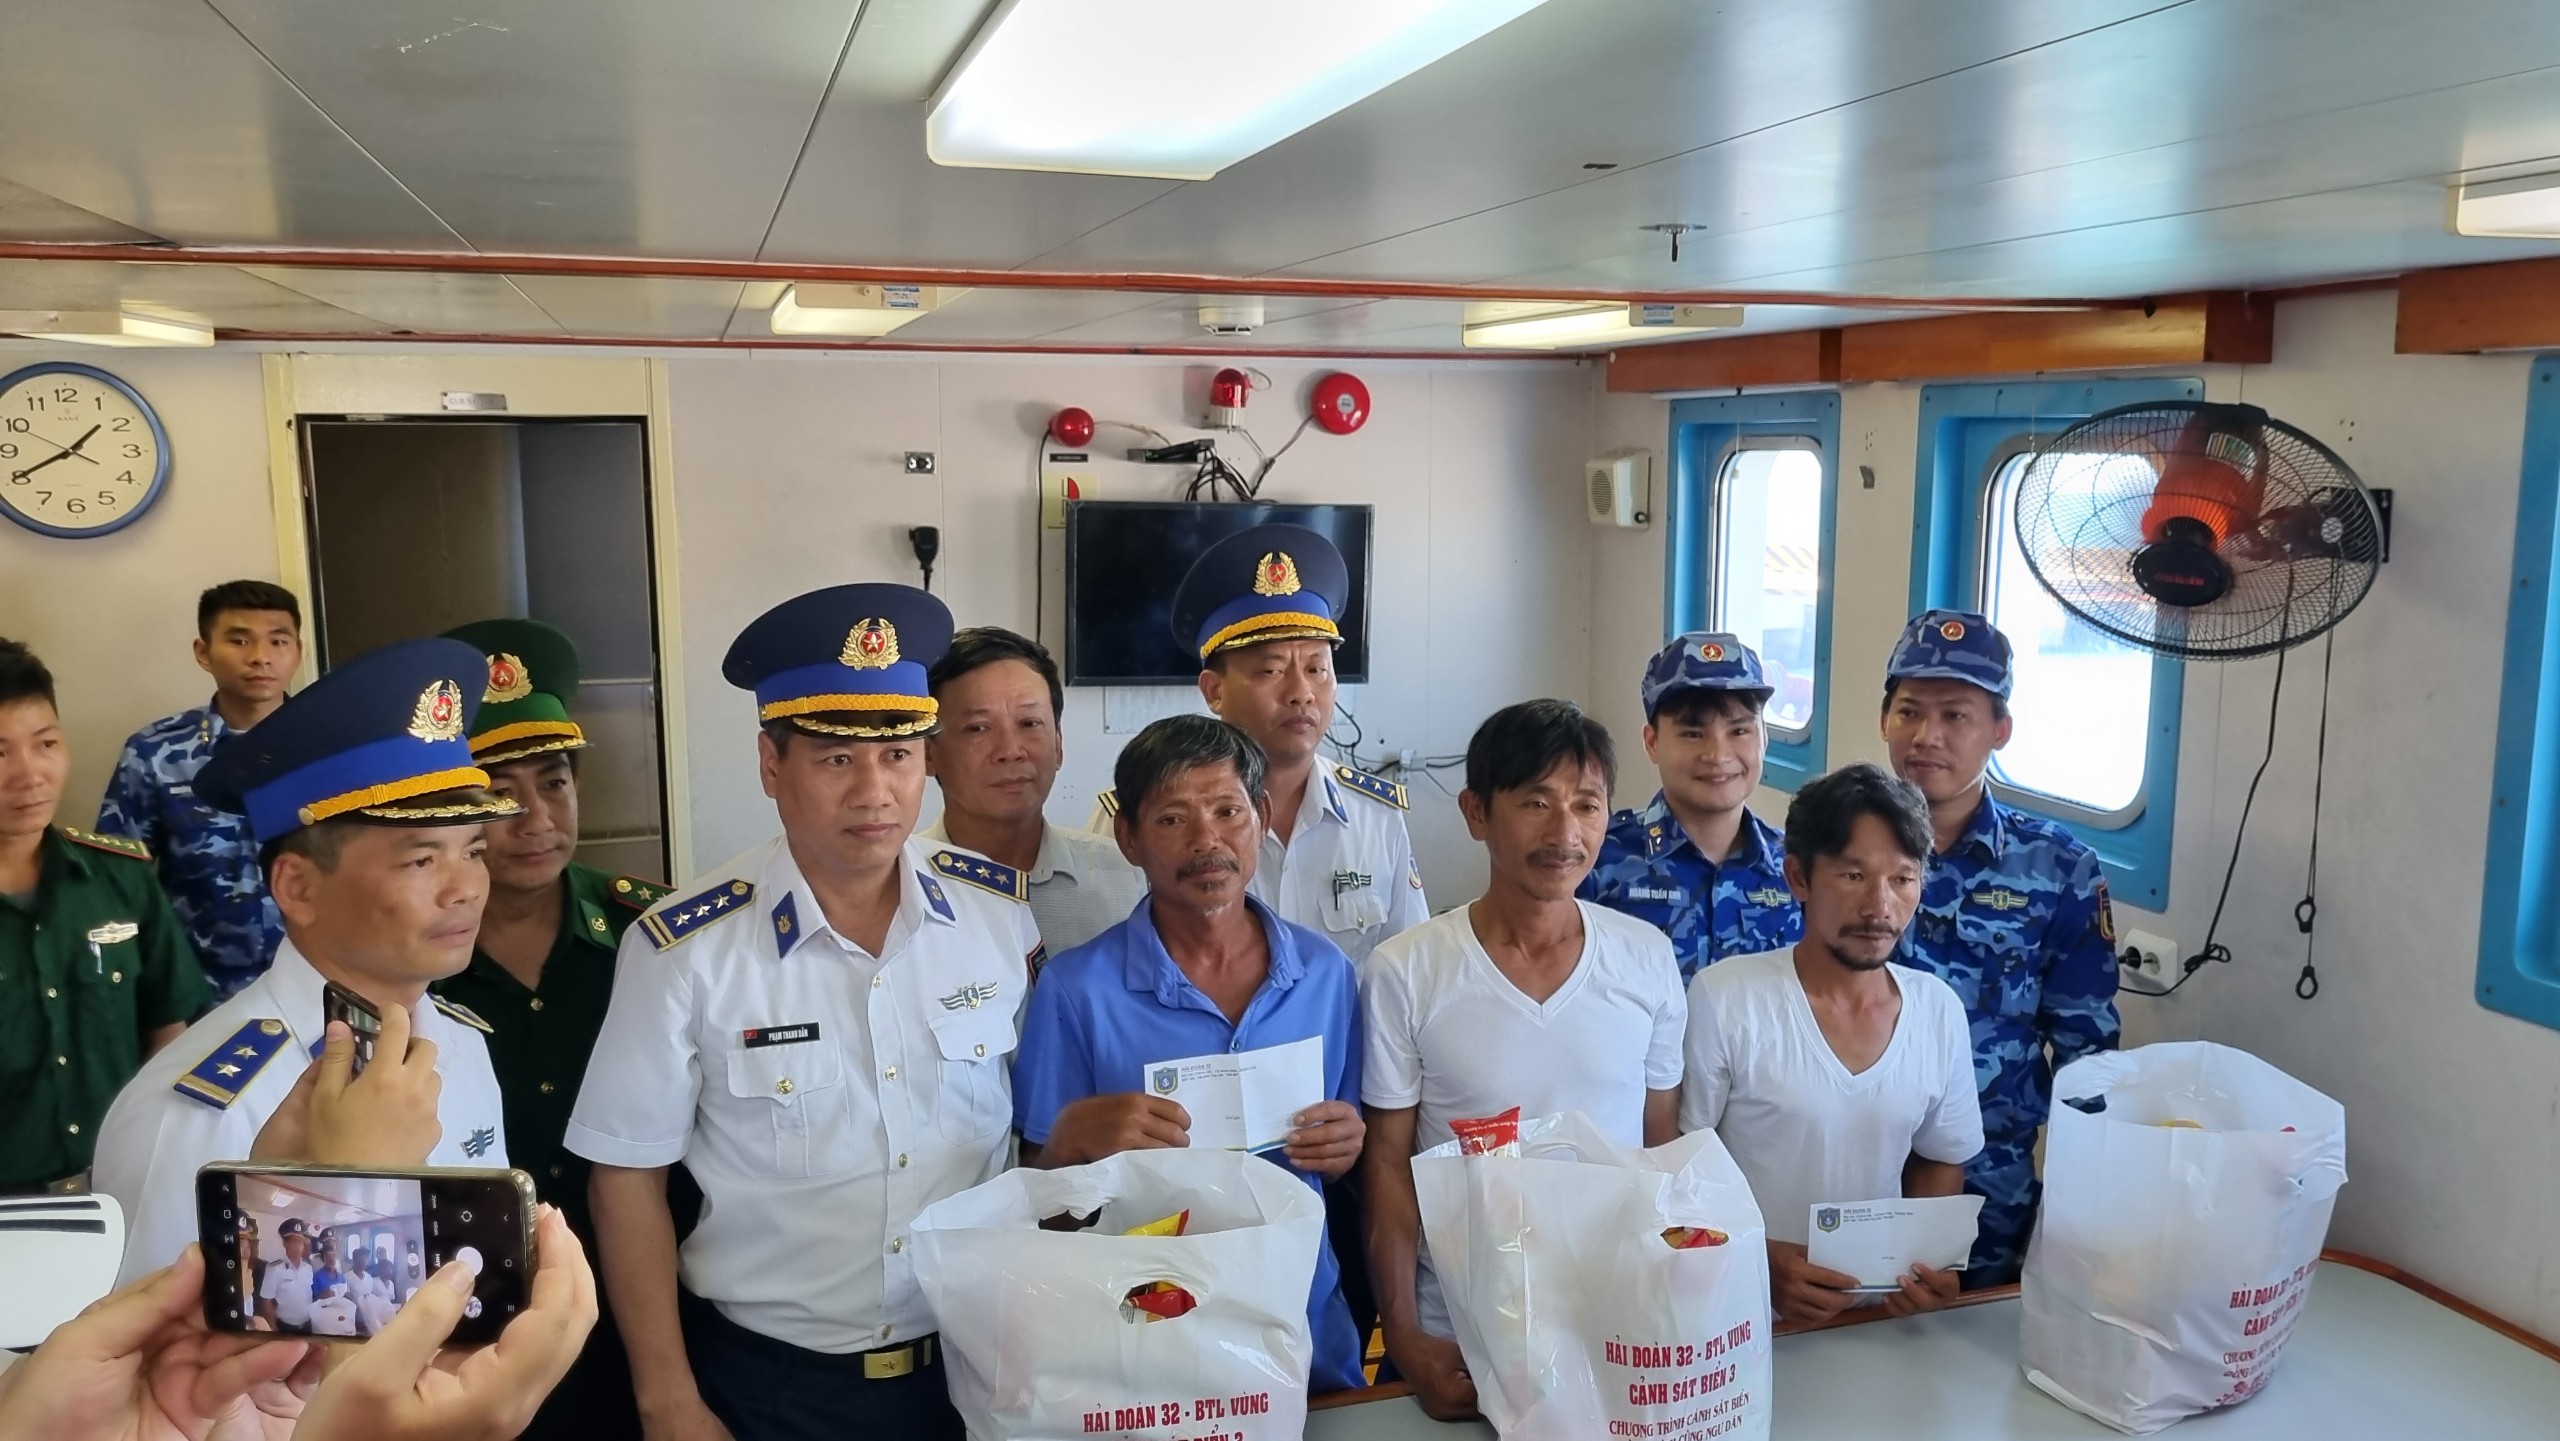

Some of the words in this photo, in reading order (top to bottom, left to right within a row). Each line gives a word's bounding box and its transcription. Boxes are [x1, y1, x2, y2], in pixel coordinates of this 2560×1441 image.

[54, 388, 78, 403] 12
[27, 396, 45, 411] 11
[95, 396, 102, 411] 1
[6, 417, 30, 433] 10
[112, 417, 131, 432] 2
[0, 443, 19, 459] 9
[122, 444, 142, 459] 3
[11, 470, 31, 486] 8
[115, 470, 136, 485] 4
[36, 491, 53, 506] 7
[67, 498, 86, 514] 6
[98, 491, 116, 506] 5
[1605, 1334, 1628, 1367] HẢI
[1632, 1340, 1671, 1368] ĐOÀN
[1676, 1344, 1694, 1368] 32
[1705, 1335, 1726, 1361] BTL
[1727, 1320, 1751, 1351] VÙNG
[1629, 1375, 1668, 1406] CẢNH
[1672, 1376, 1697, 1403] SÁT
[1700, 1360, 1727, 1396] BIỂN
[1729, 1363, 1736, 1383] 3
[1083, 1402, 1111, 1433] HẢI
[1115, 1401, 1156, 1431] ĐOÀN
[1161, 1402, 1180, 1426] 32
[1195, 1398, 1225, 1422] BTL
[1230, 1390, 1269, 1417] VÙNG
[1656, 1416, 1685, 1436] TRÌNH
[1713, 1399, 1730, 1418] SÁT
